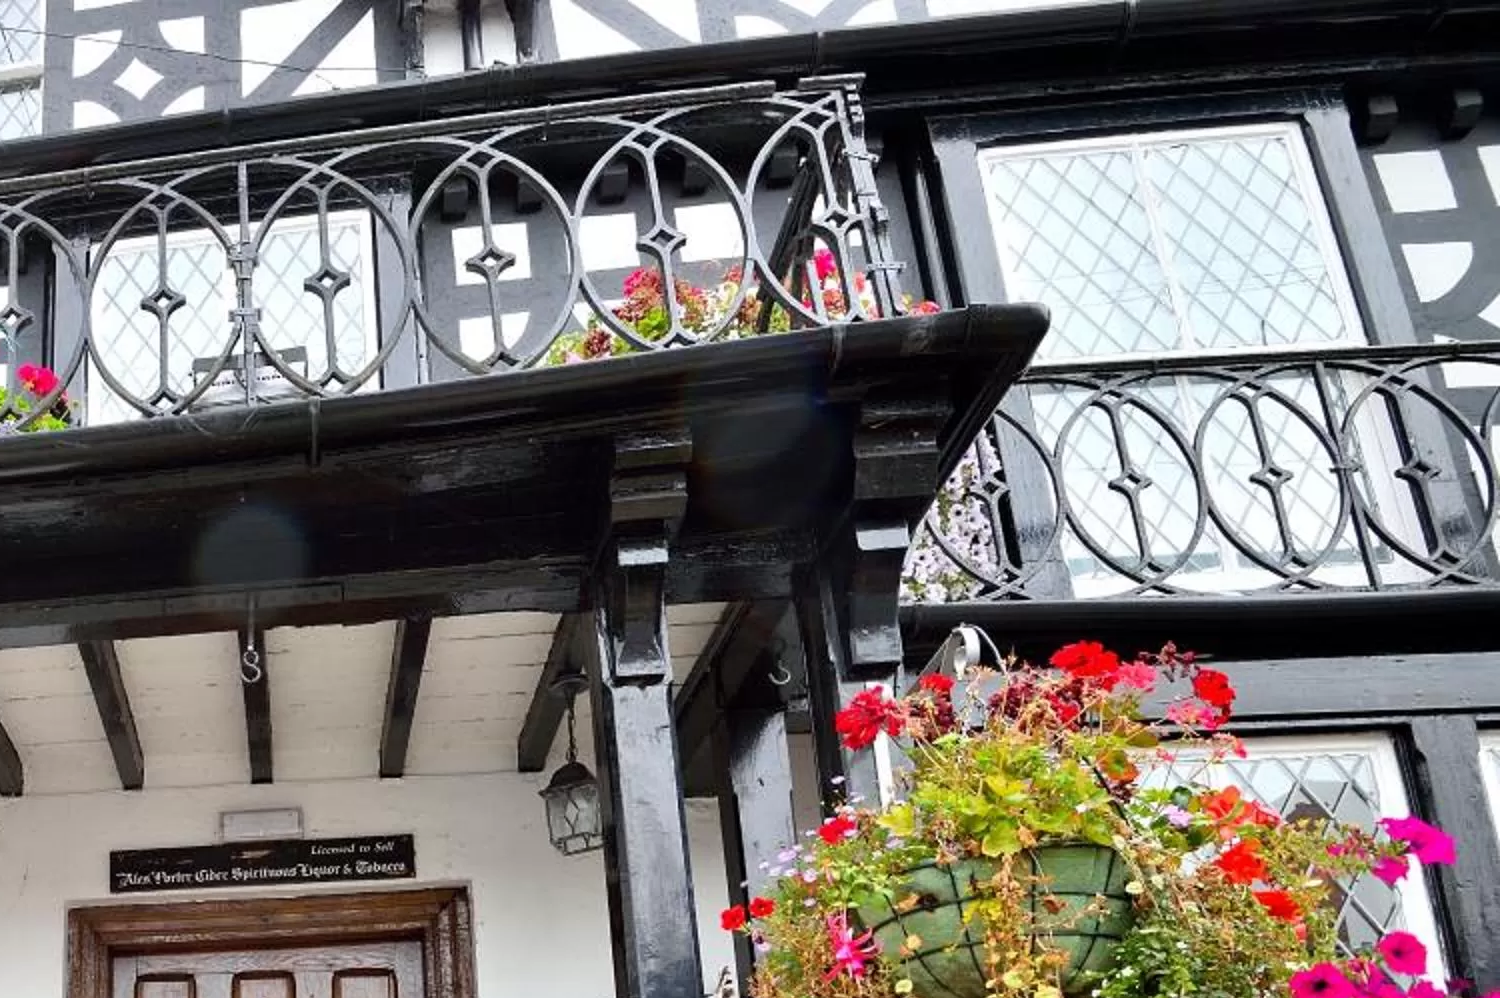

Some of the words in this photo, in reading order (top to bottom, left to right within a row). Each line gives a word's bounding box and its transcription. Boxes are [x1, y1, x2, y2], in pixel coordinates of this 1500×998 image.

[311, 843, 355, 855] Licensed
[359, 844, 370, 853] to
[374, 841, 395, 853] Sell
[195, 869, 229, 883] Cider
[297, 863, 340, 878] Liquor
[343, 863, 352, 875] &
